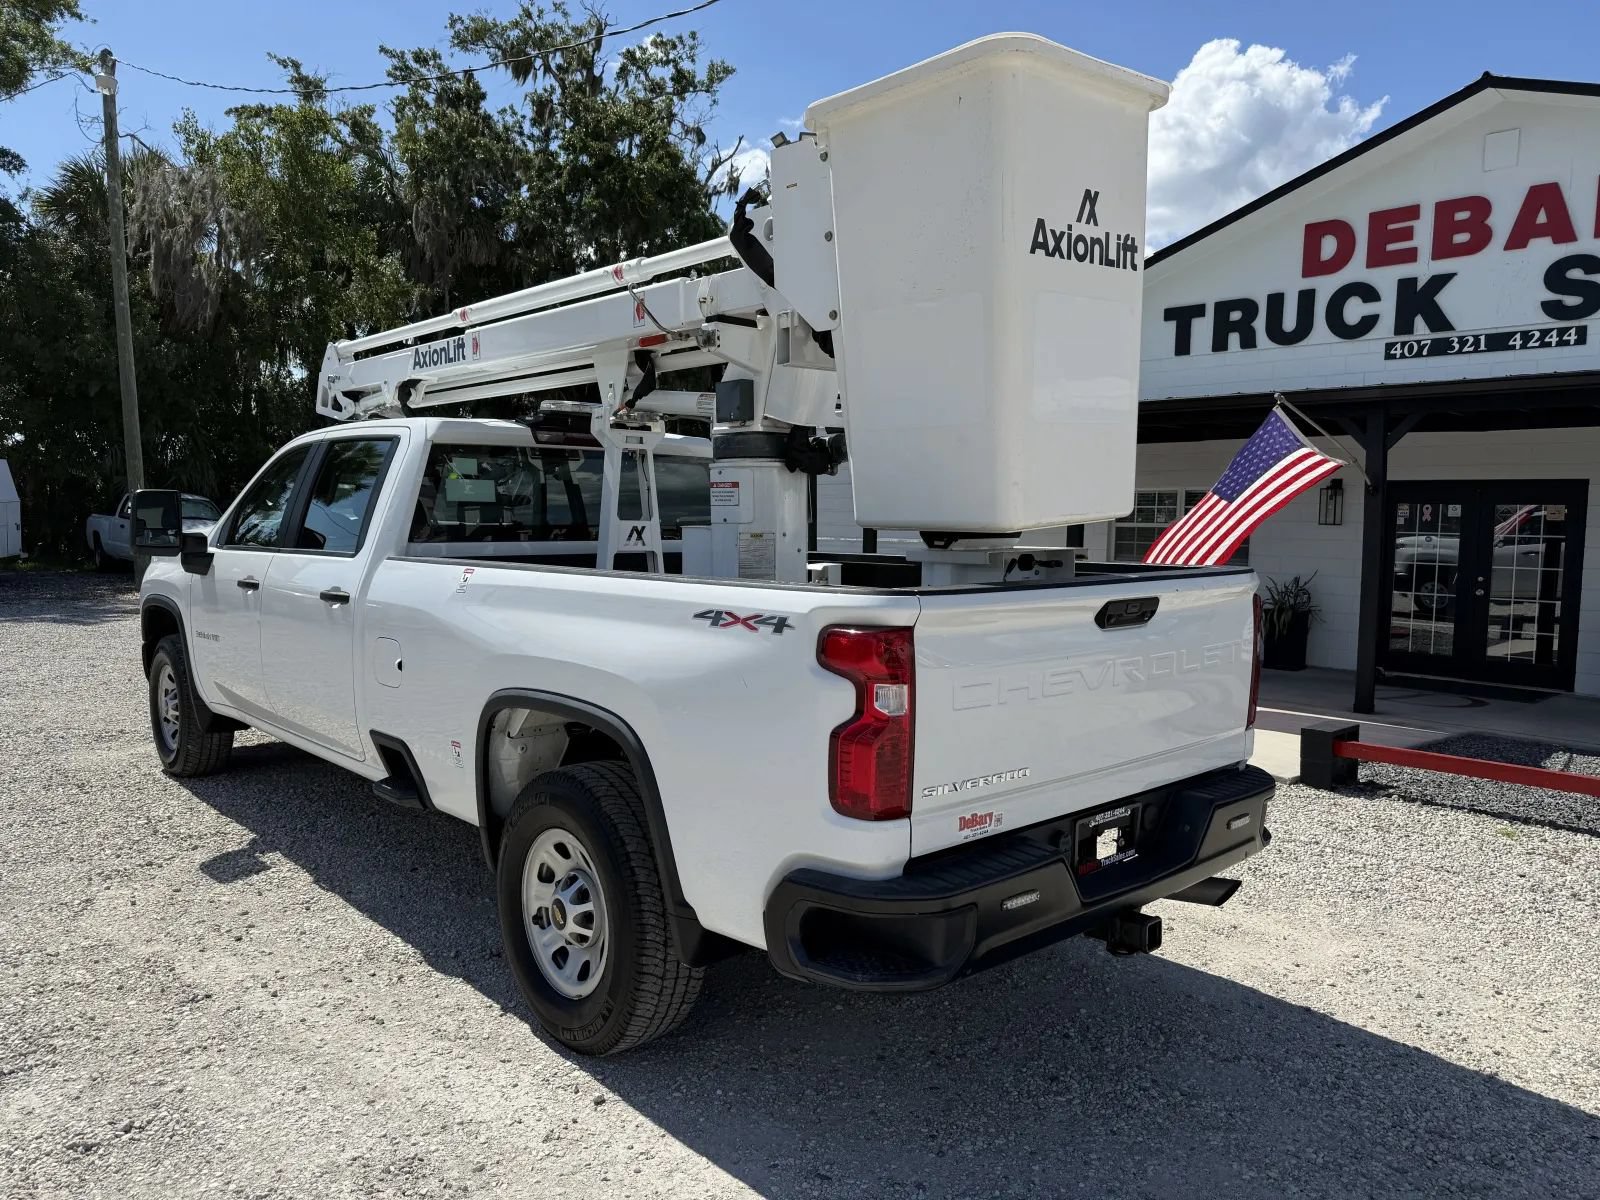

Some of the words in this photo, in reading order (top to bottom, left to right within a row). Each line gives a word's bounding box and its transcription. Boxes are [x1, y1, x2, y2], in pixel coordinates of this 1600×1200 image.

[1029, 217, 1138, 272] AxionLift
[1302, 174, 1600, 279] DEBA
[1163, 272, 1459, 356] TRUCK
[412, 337, 466, 371] AxionLift
[1389, 339, 1432, 359] 407
[1447, 334, 1488, 354] 321
[1508, 326, 1578, 350] 4244
[953, 639, 1242, 711] CHEVROLET
[921, 767, 1032, 799] SILVERADO
[958, 811, 994, 833] DeBary
